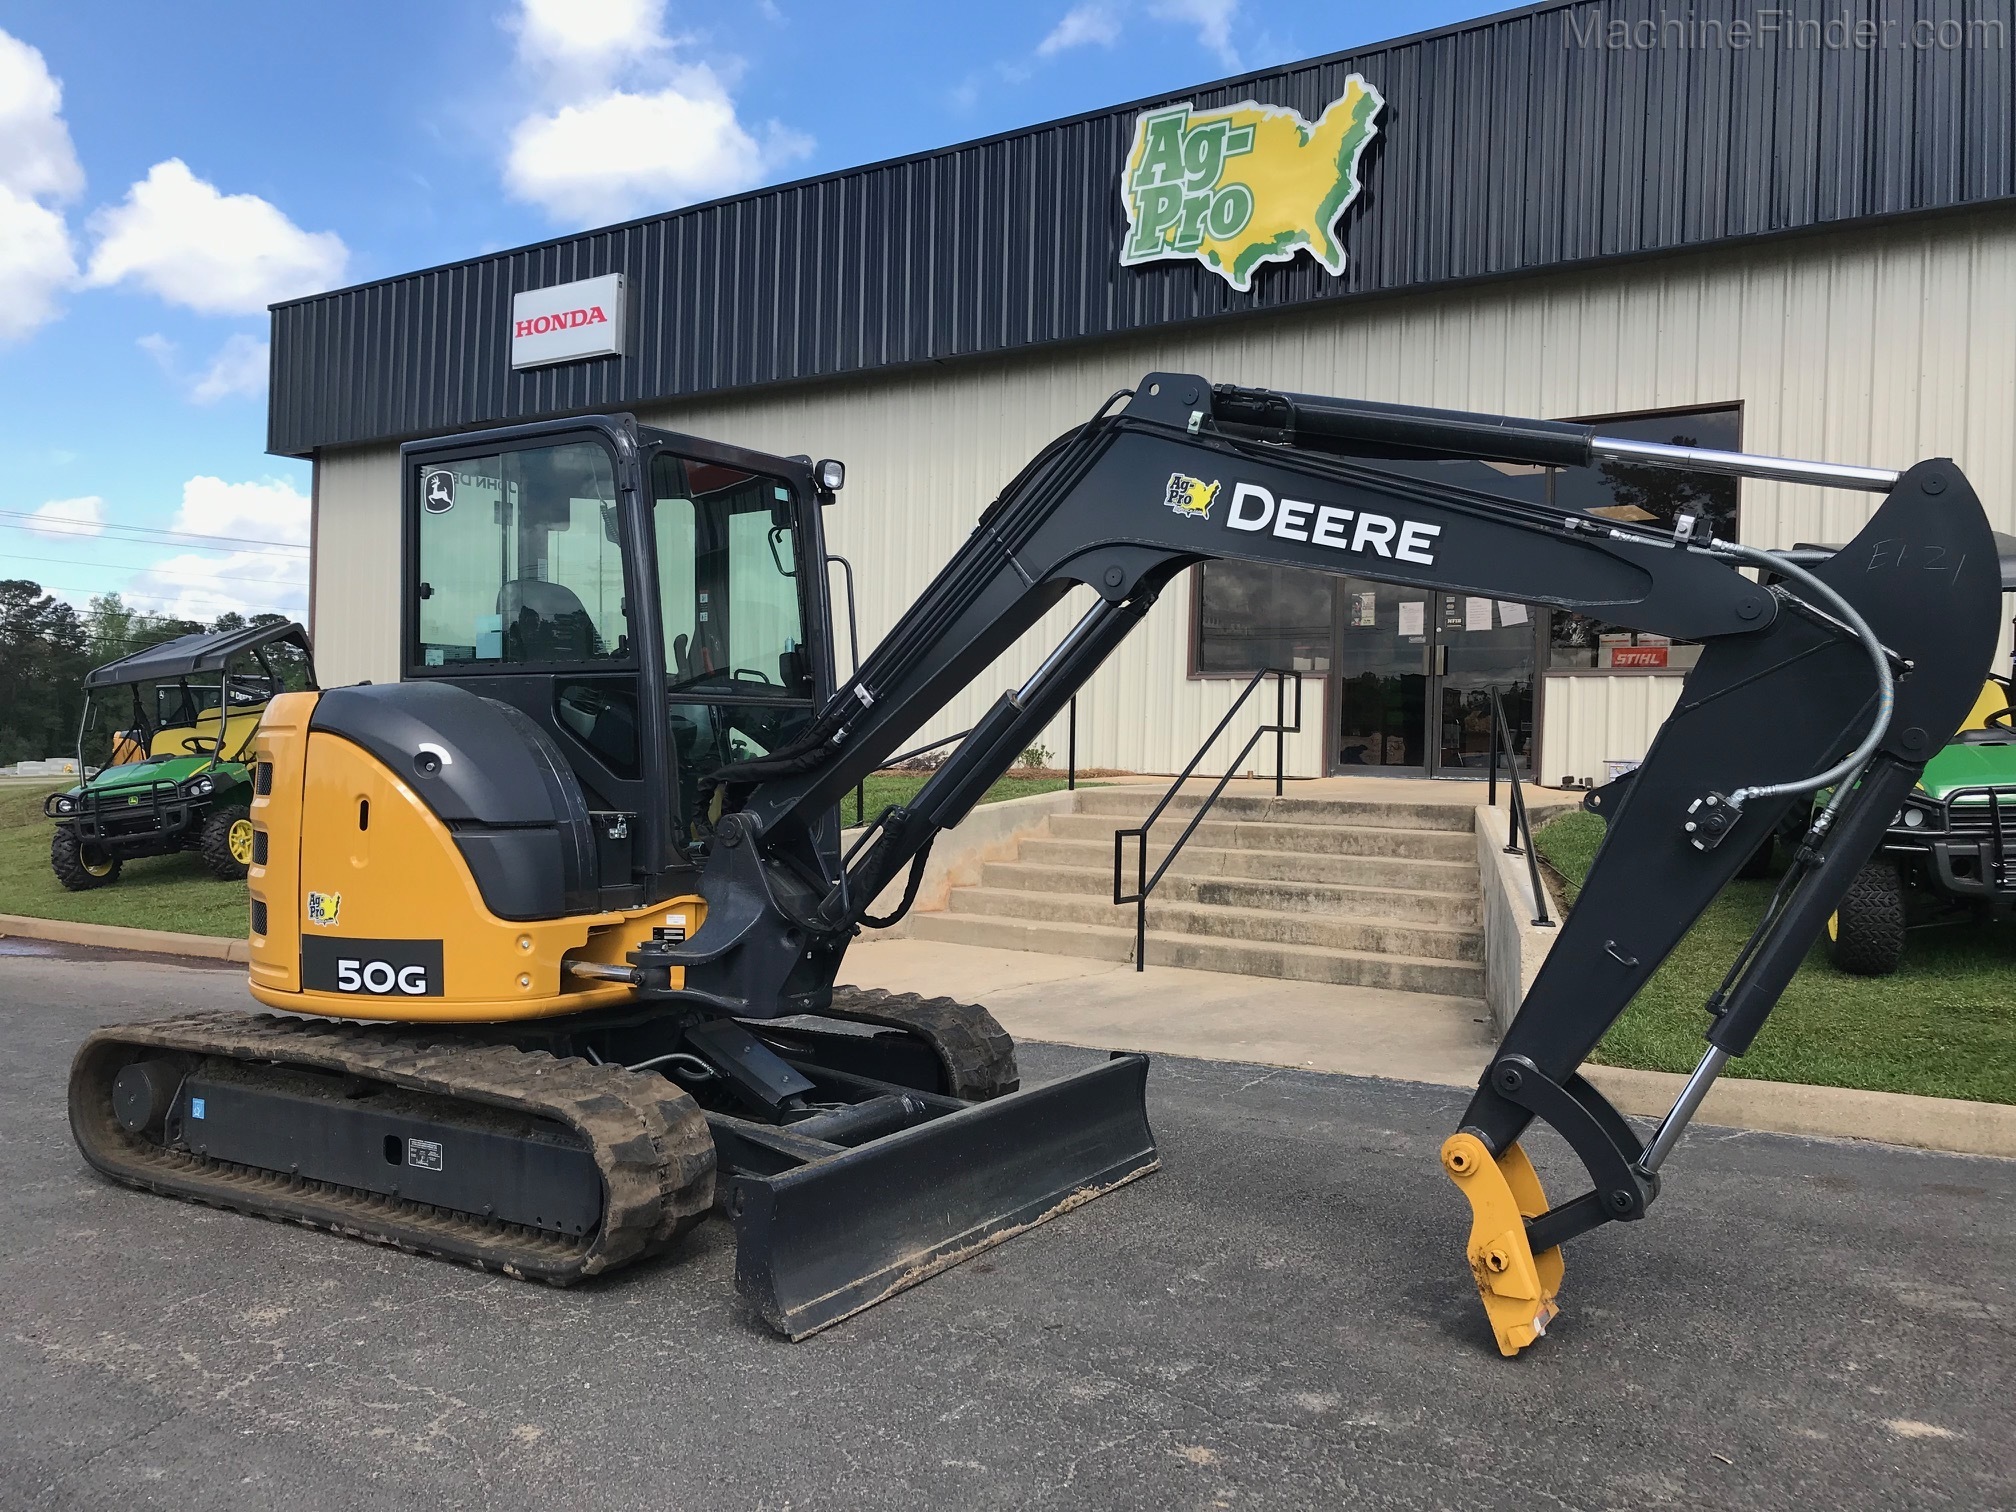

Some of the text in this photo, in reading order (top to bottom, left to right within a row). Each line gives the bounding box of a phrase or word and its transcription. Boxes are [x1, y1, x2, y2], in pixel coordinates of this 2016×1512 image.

[1129, 109, 1257, 192] Ag-
[1128, 182, 1254, 258] Pro
[515, 306, 607, 338] HONDA
[1167, 490, 1192, 505] Pro
[1169, 476, 1195, 493] Ag-
[1226, 482, 1442, 566] DEERE
[1614, 653, 1660, 665] STIHL
[309, 905, 325, 918] Pro
[338, 959, 427, 995] 50G
